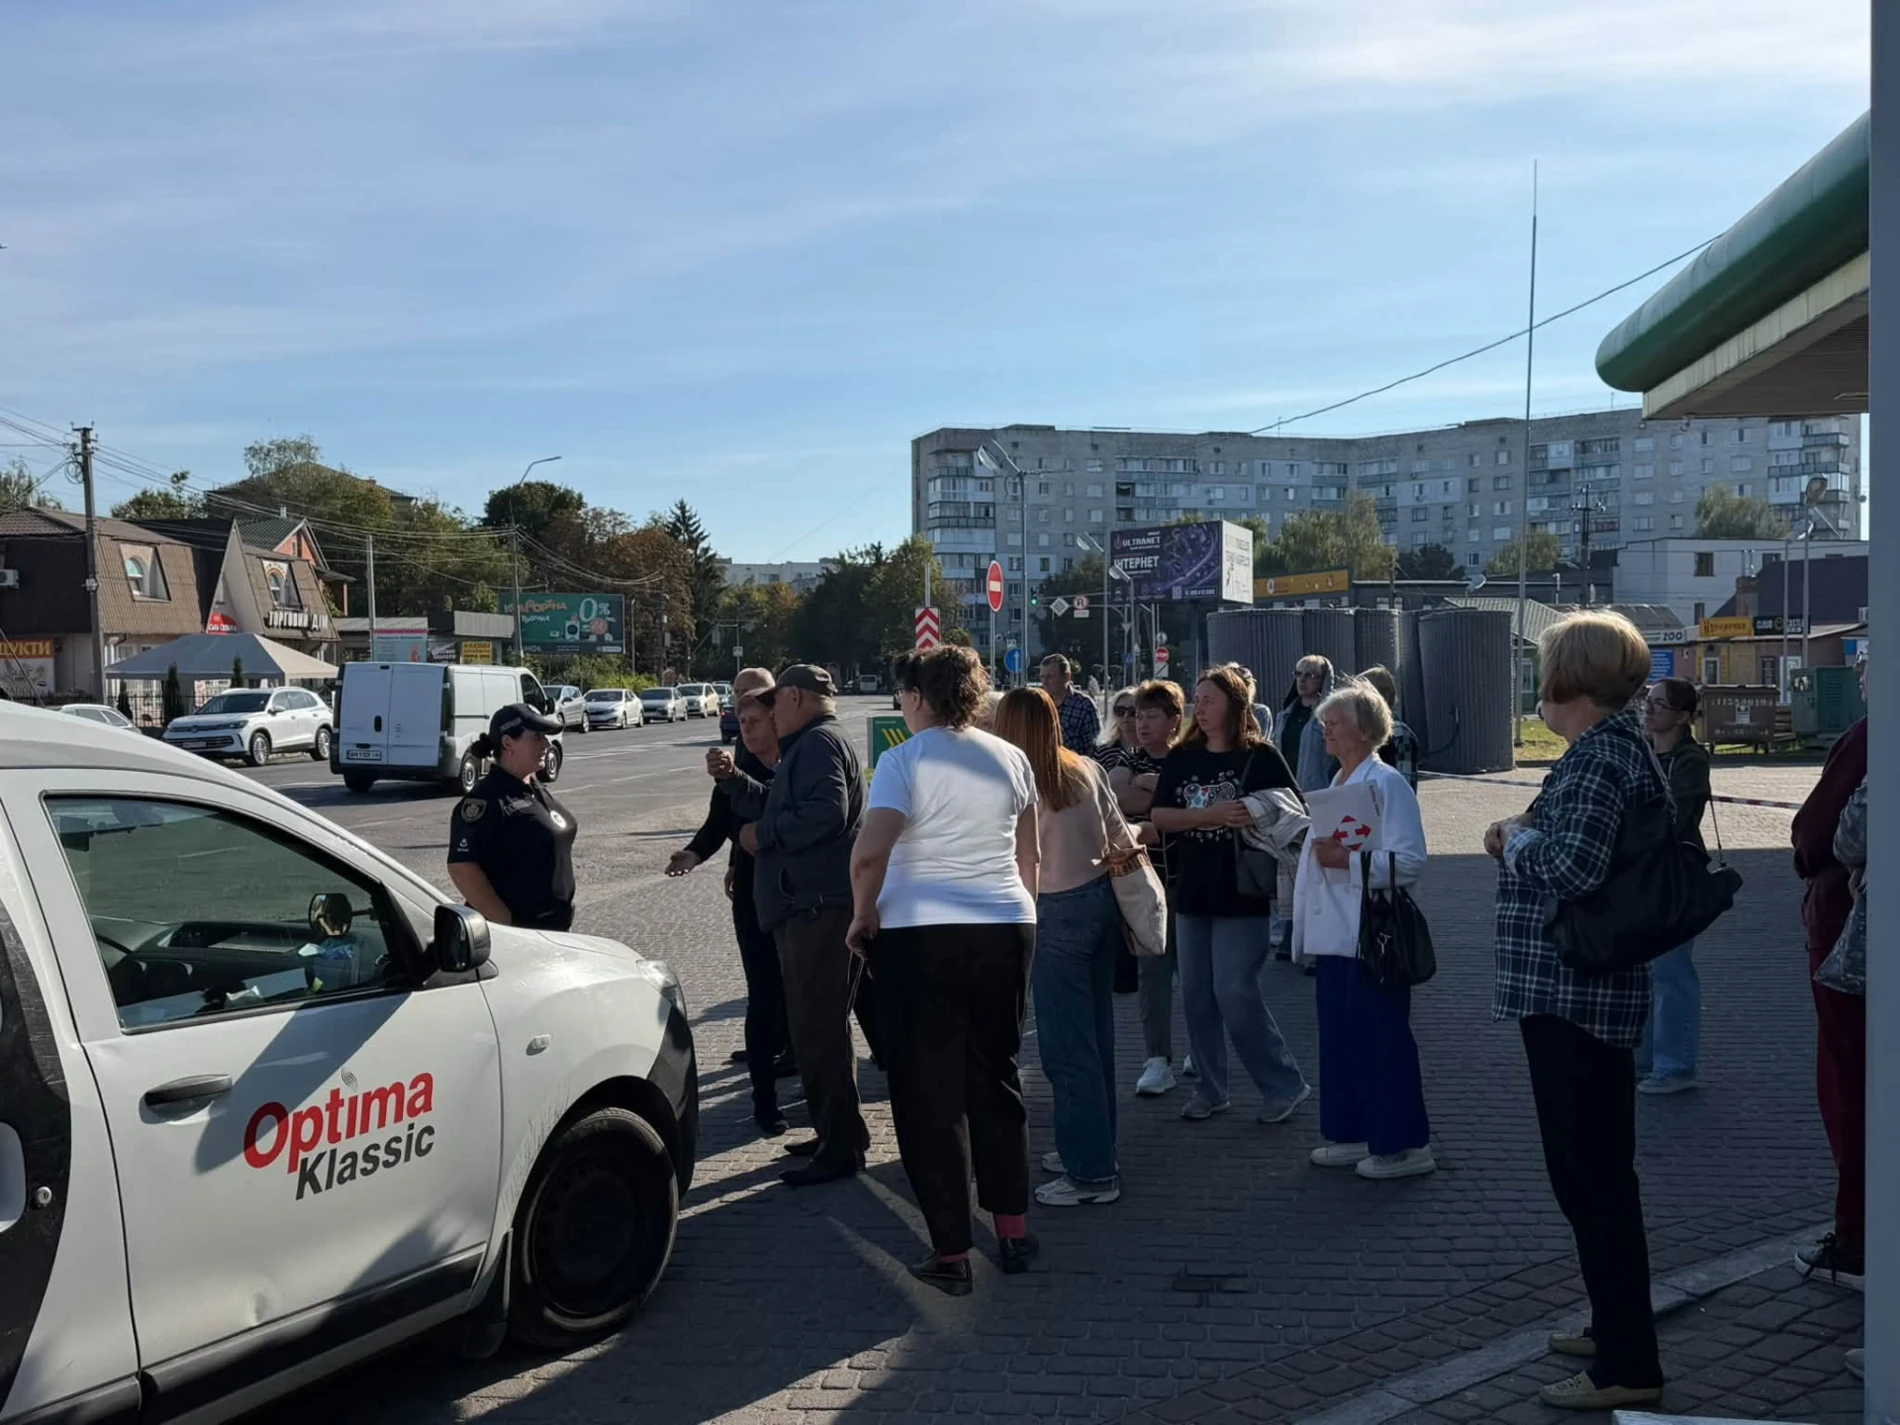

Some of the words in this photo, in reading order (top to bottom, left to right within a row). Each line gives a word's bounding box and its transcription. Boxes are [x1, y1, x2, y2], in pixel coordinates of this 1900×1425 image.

[1122, 535, 1161, 547] ULTRANET
[243, 1070, 434, 1175] Optima
[295, 1123, 435, 1201] Klassic
